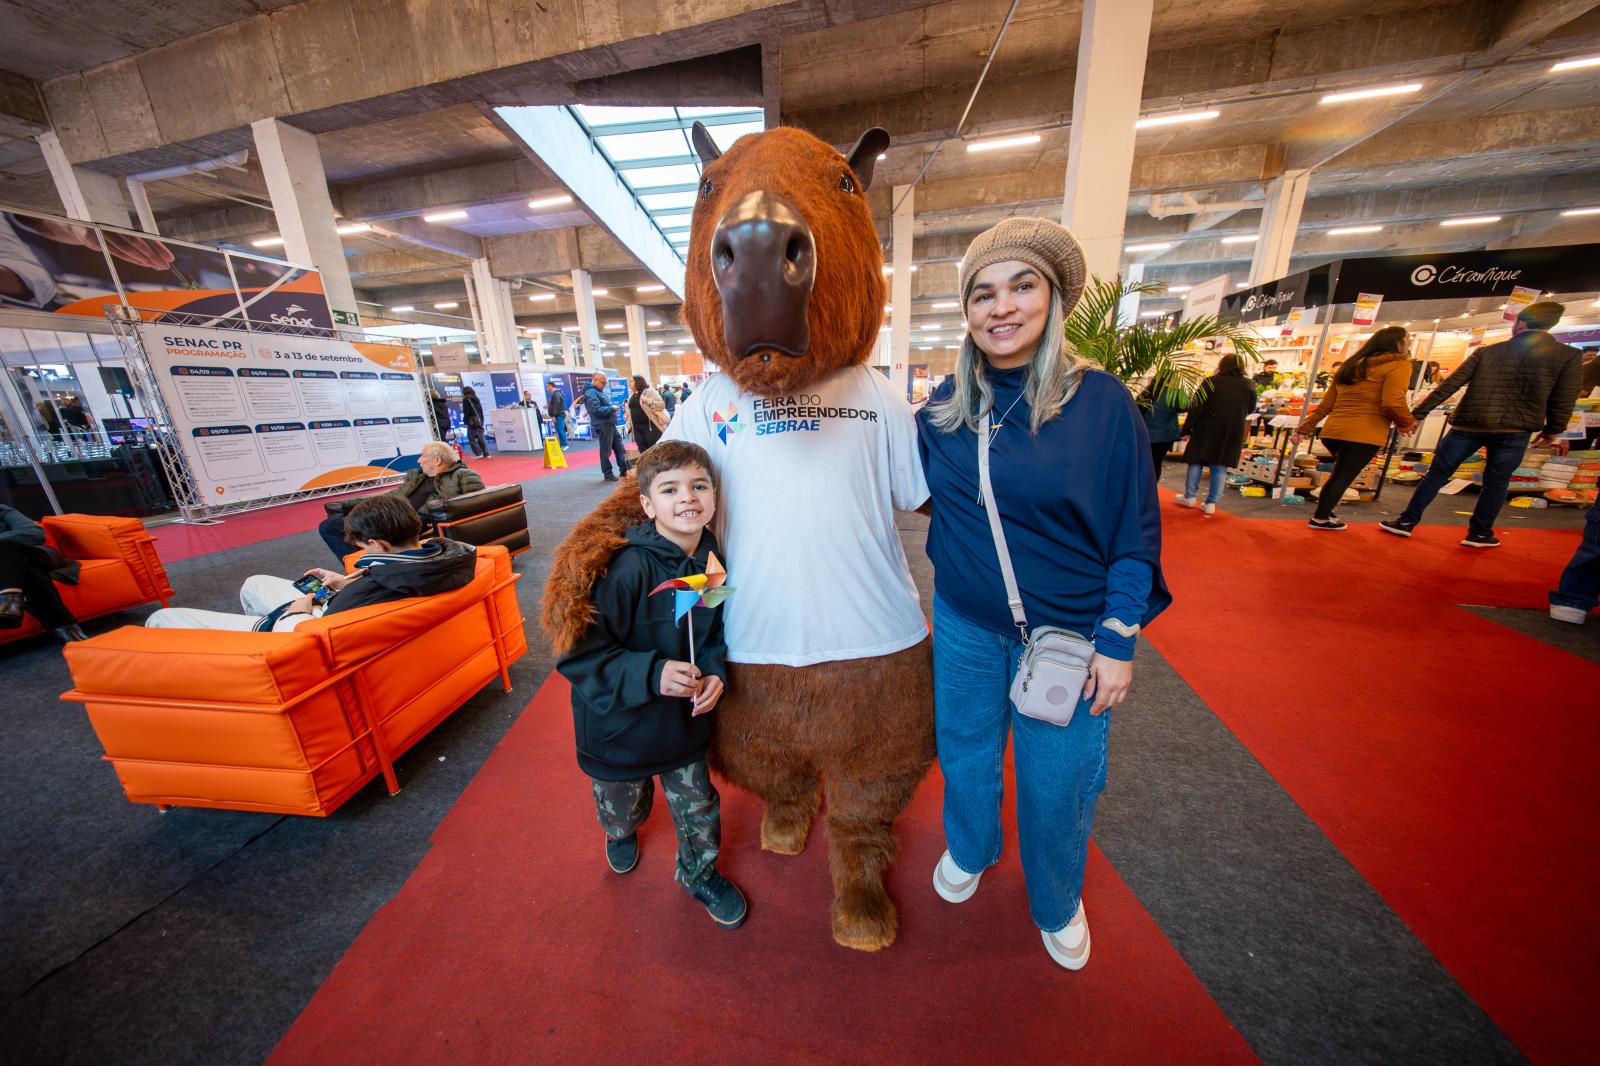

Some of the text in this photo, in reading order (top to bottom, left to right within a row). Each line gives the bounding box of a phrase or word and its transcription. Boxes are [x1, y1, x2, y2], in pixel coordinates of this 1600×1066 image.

[1438, 265, 1522, 292] Céramique
[270, 313, 315, 328] Senac
[163, 336, 243, 351] SENAC PR
[166, 348, 247, 359] PROGRAMAÇÃO
[274, 350, 282, 359] 3
[292, 351, 303, 360] 13
[304, 352, 318, 361] de
[320, 353, 363, 363] setembro
[753, 394, 821, 410] FEIRA DO
[753, 406, 878, 423] EMPREENDEDOR
[755, 419, 821, 436] SEBRAE
